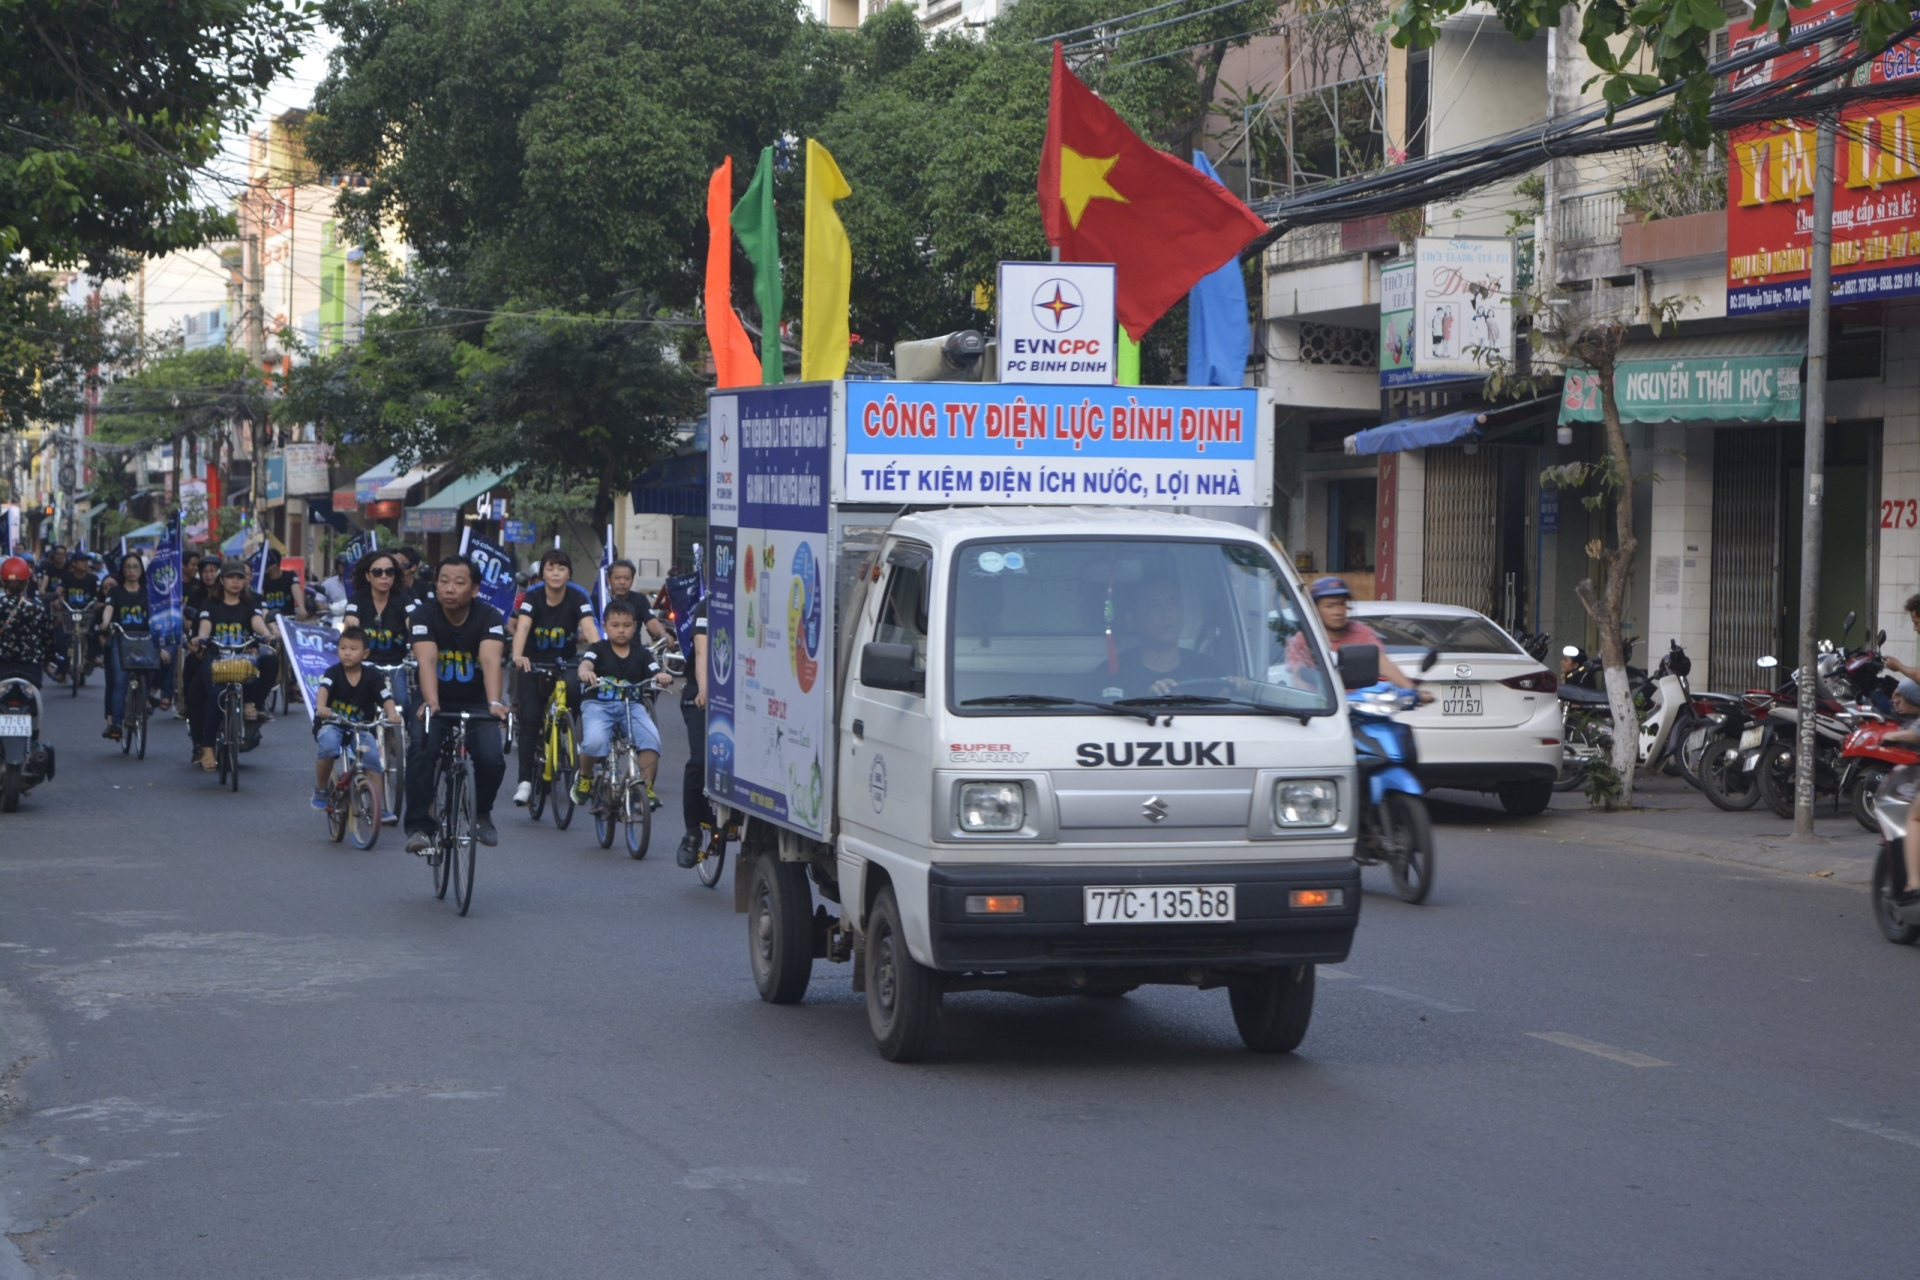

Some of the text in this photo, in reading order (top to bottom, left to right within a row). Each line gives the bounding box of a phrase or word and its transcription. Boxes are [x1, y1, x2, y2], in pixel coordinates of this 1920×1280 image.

[1832, 207, 1854, 231] cung
[1857, 195, 1874, 225] cấp
[1014, 339, 1100, 355] EVNCPC
[1007, 361, 1107, 372] PC BINH DINH
[1626, 361, 1689, 402] NGUYỄN
[1695, 361, 1732, 400] THÁI
[1739, 368, 1773, 406] HỌC
[863, 393, 1243, 452] CÔNG TY ĐIỆN LỰC BÌNH ĐỊNH
[861, 460, 1241, 500] TIẾT KIỆM ĐIỆN ÍCH NƯỚC, LỢI NHÀ
[1881, 499, 1918, 529] 273
[1450, 686, 1472, 699] 77A
[1443, 700, 1480, 713] 077.57
[949, 752, 1029, 763] CARRY
[950, 743, 1011, 751] SUPER
[1076, 741, 1236, 767] SUZUKI
[1092, 891, 1229, 919] 77C-135.68
